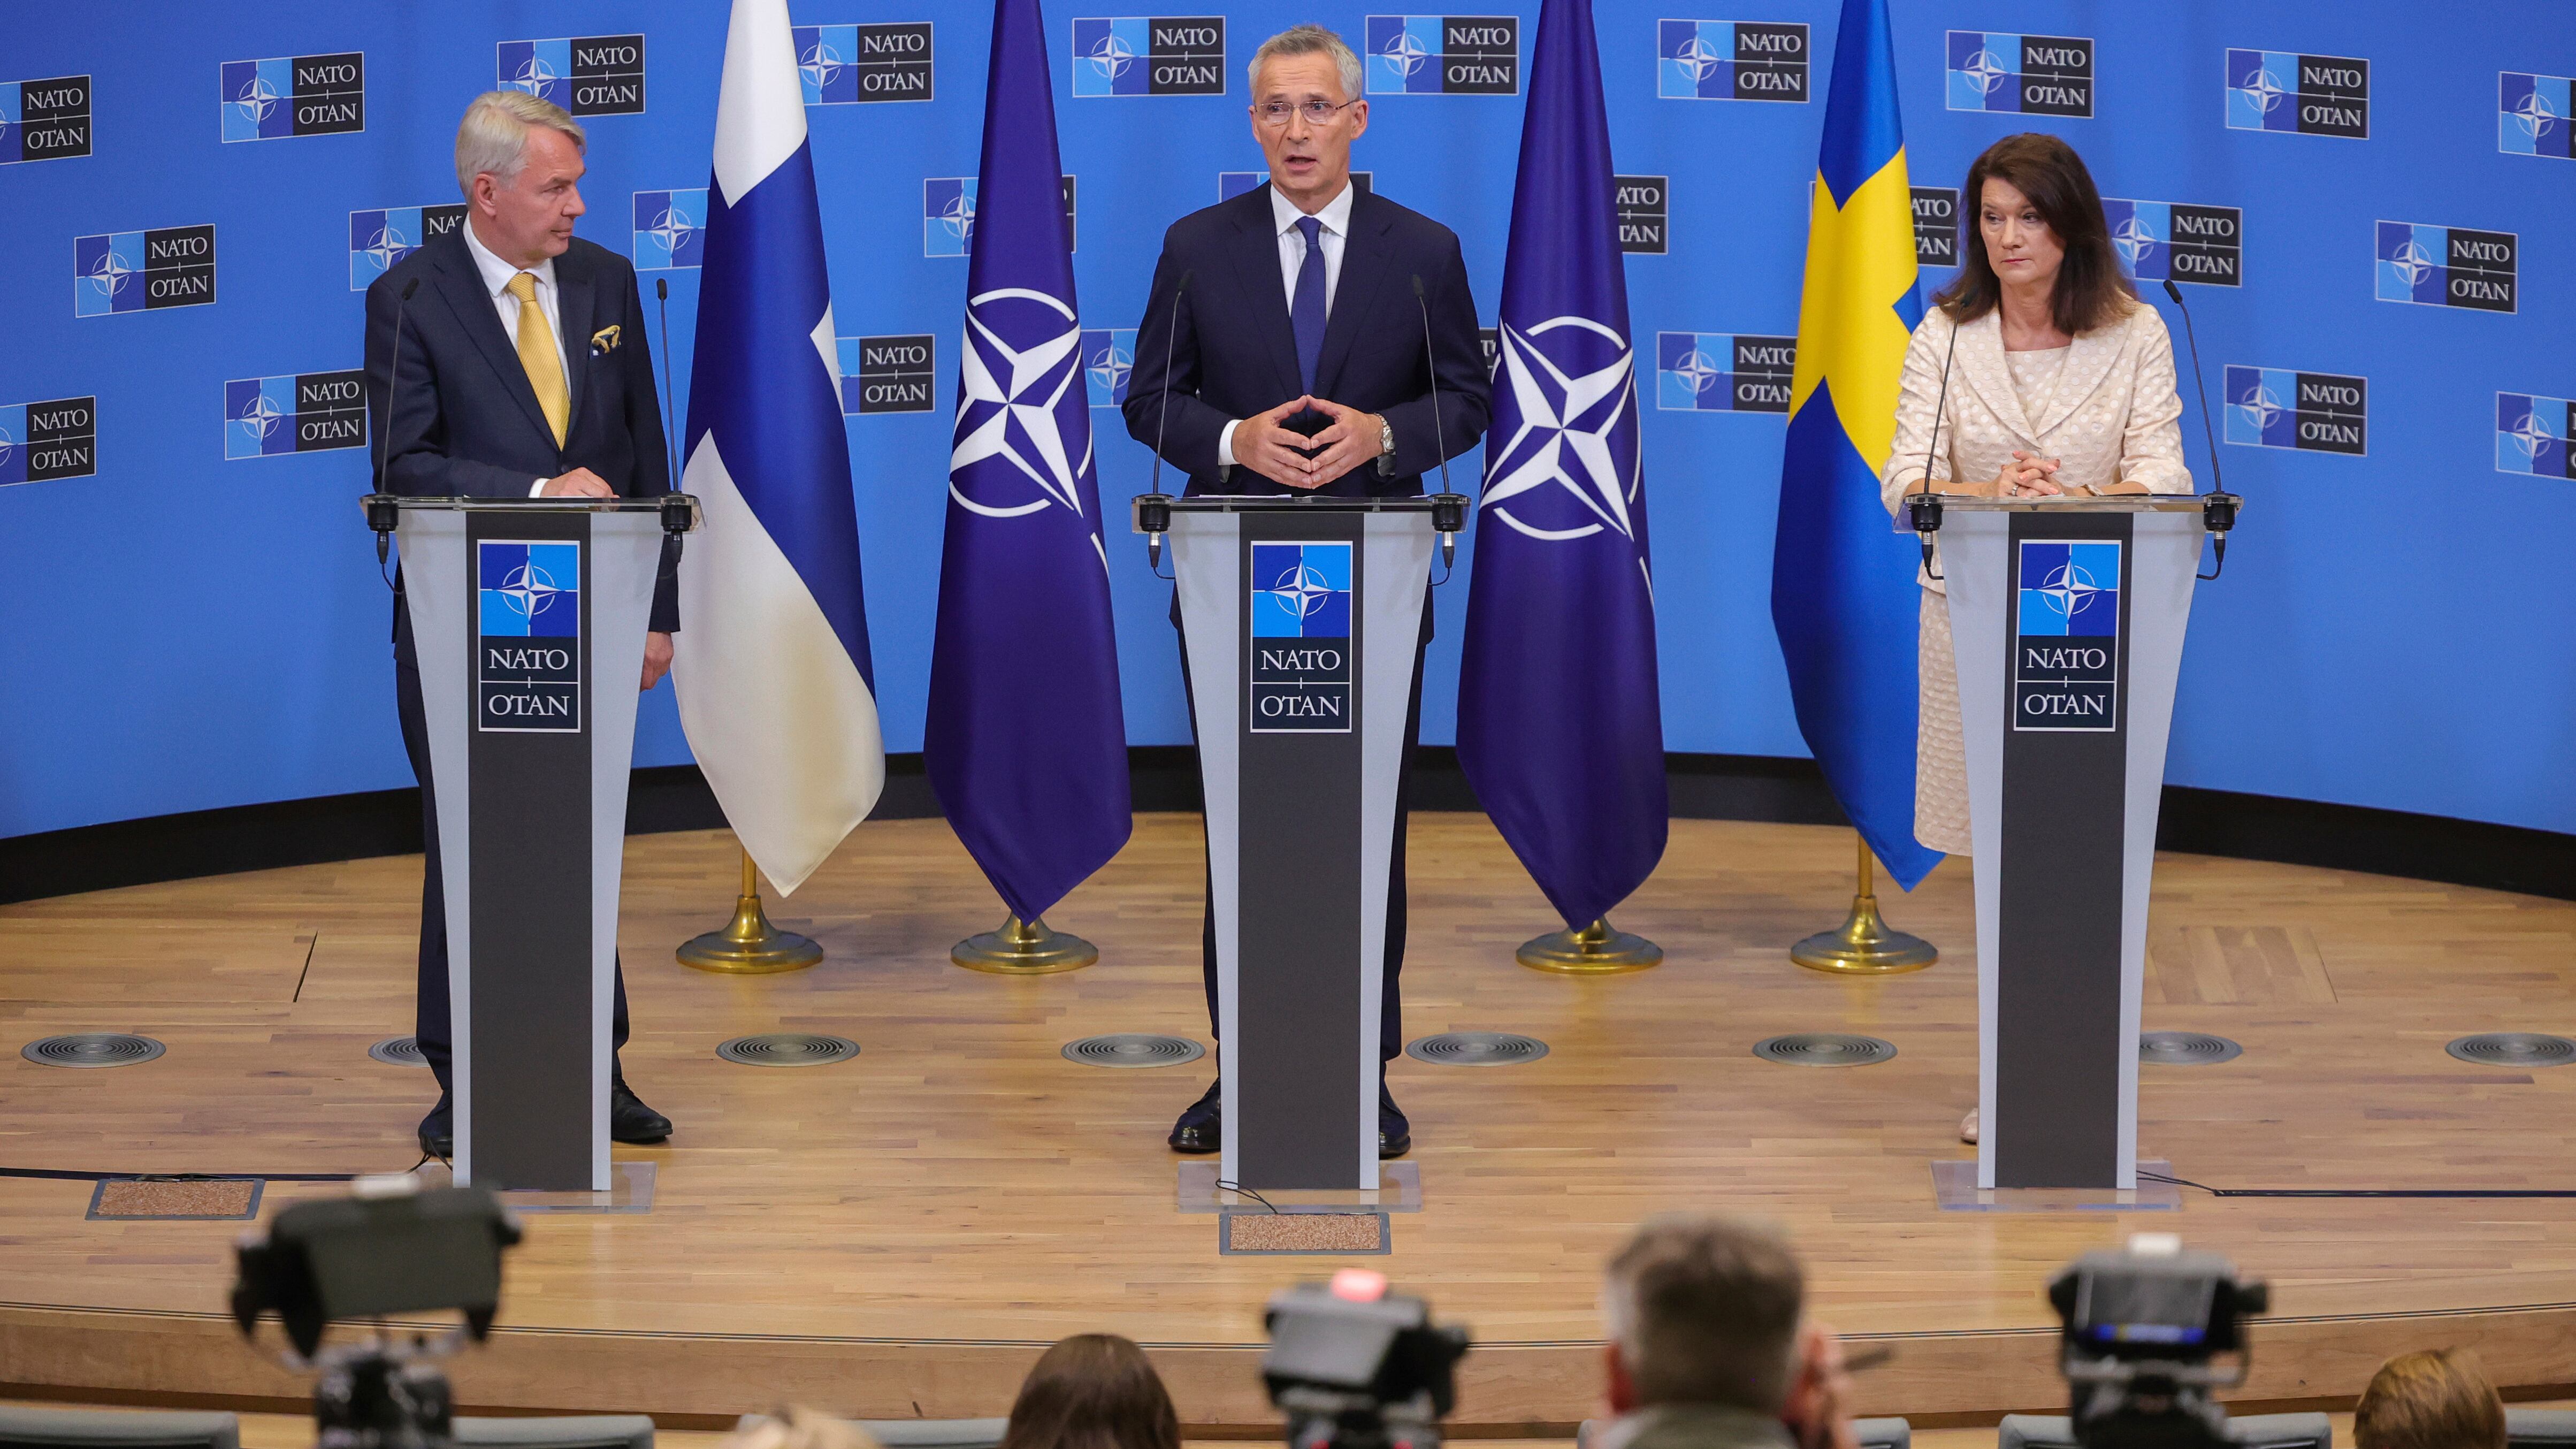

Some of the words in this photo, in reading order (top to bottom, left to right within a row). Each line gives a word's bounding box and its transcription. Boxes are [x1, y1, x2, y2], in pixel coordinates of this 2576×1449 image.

[863, 34, 925, 53] NATO
[1155, 28, 1217, 46] NATO
[1449, 27, 1511, 45] NATO
[1740, 33, 1801, 52] NATO
[577, 46, 637, 66] NATO
[2026, 47, 2086, 67] NATO
[298, 64, 356, 86] NATO
[863, 72, 926, 91] OTAN
[1155, 66, 1218, 84] OTAN
[1448, 65, 1511, 83] OTAN
[1739, 72, 1801, 90] OTAN
[2303, 66, 2361, 88] NATO
[27, 88, 83, 110] NATO
[577, 85, 637, 105] OTAN
[2025, 85, 2086, 106] OTAN
[299, 103, 357, 124] OTAN
[2302, 105, 2362, 127] OTAN
[27, 127, 84, 149] OTAN
[1616, 187, 1660, 205] ATO
[1912, 198, 1952, 217] ATO
[428, 215, 462, 235] NA
[1619, 224, 1660, 243] TAN
[2176, 215, 2234, 236] NATO
[151, 237, 208, 259] NATO
[1915, 237, 1951, 255] AN
[2452, 239, 2510, 262] NATO
[2174, 254, 2234, 274] OTAN
[151, 275, 208, 298] OTAN
[2451, 278, 2510, 301] OTAN
[866, 346, 927, 365] NATO
[302, 381, 360, 403] NATO
[865, 384, 927, 402] OTAN
[2302, 383, 2360, 406] NATO
[33, 409, 88, 431] NATO
[301, 419, 360, 440] OTAN
[2300, 422, 2359, 444] OTAN
[32, 447, 89, 470] OTAN
[488, 649, 569, 670] NATO
[1260, 649, 1341, 670] NATO
[2026, 648, 2106, 669] NATO
[488, 695, 570, 716] OTAN
[1260, 695, 1341, 716] OTAN
[2024, 693, 2106, 715] OTAN
